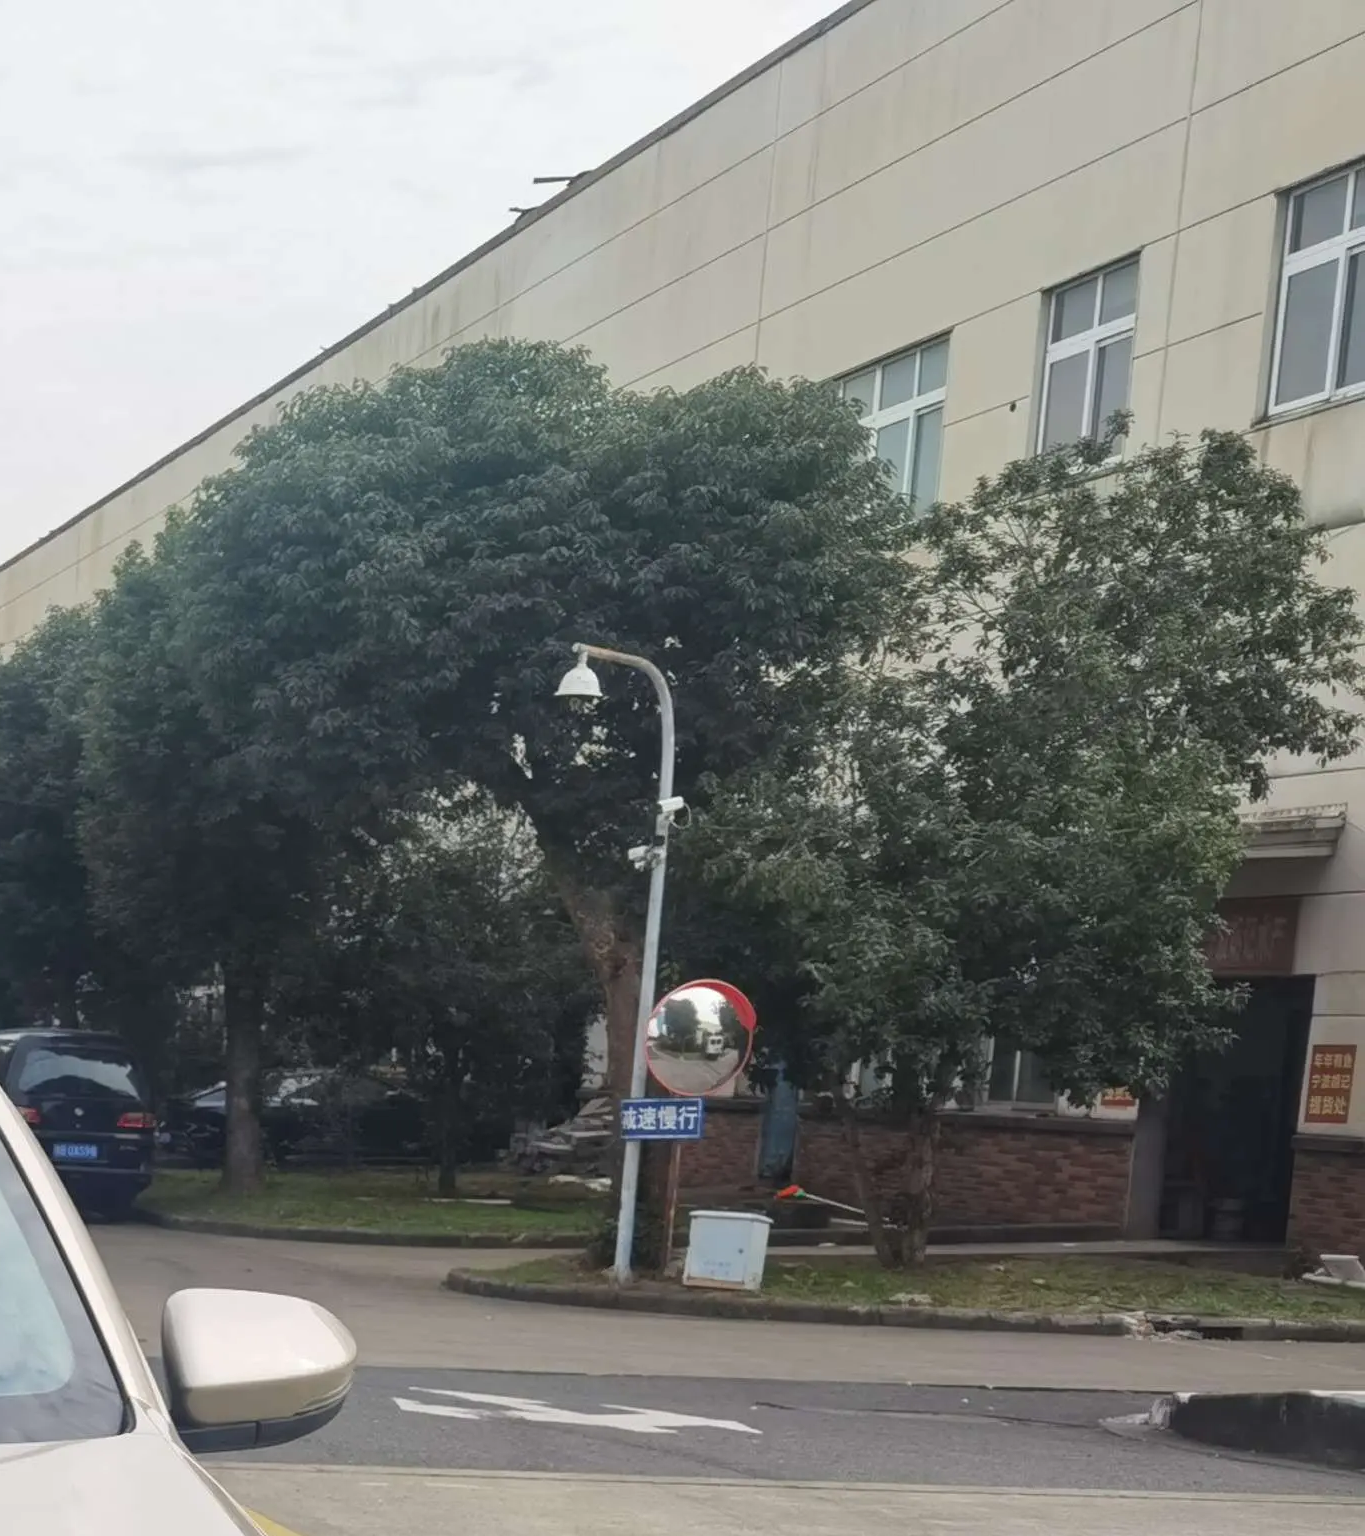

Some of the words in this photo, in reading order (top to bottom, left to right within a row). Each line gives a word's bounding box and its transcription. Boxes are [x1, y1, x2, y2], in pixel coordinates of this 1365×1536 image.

[1308, 1095, 1347, 1116] 提货处
[621, 1105, 699, 1130] 减速慢行
